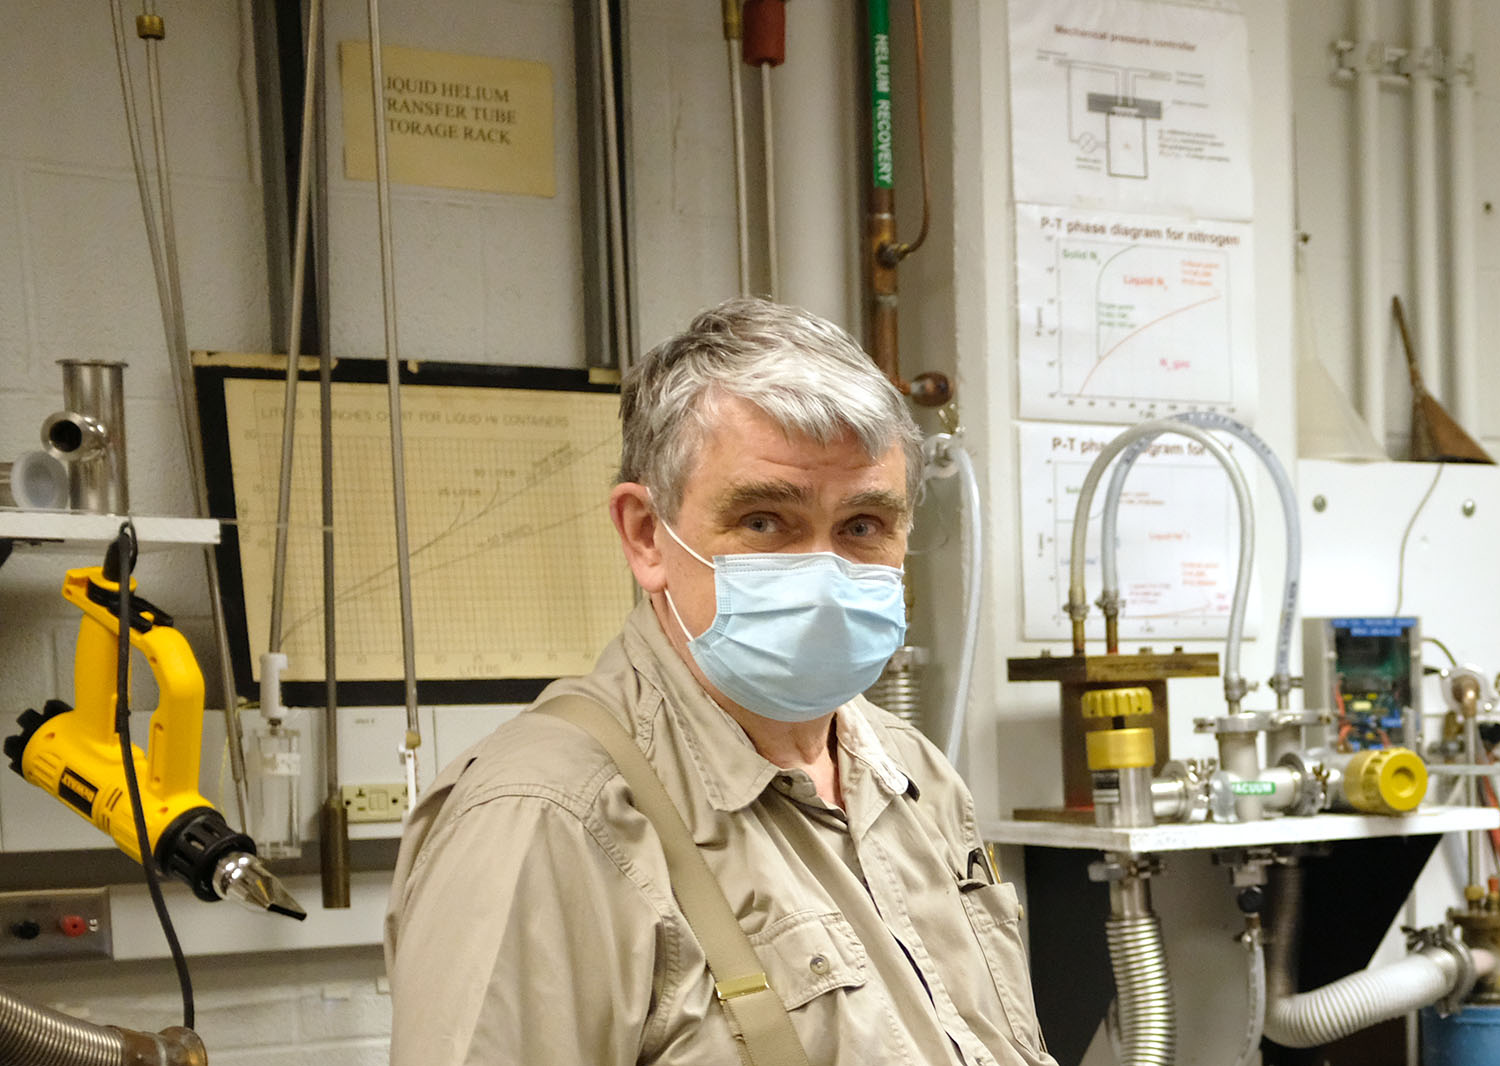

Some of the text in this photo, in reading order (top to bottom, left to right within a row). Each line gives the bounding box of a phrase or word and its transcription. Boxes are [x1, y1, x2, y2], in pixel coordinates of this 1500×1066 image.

[385, 76, 511, 103] IQUID HELIUM
[385, 98, 518, 125] RANSFER TUBE
[875, 33, 893, 185] HELIUM RECOVERY
[386, 118, 512, 146] TORAGE RACK
[1041, 217, 1241, 247] P-T phase diagram for nitrogen
